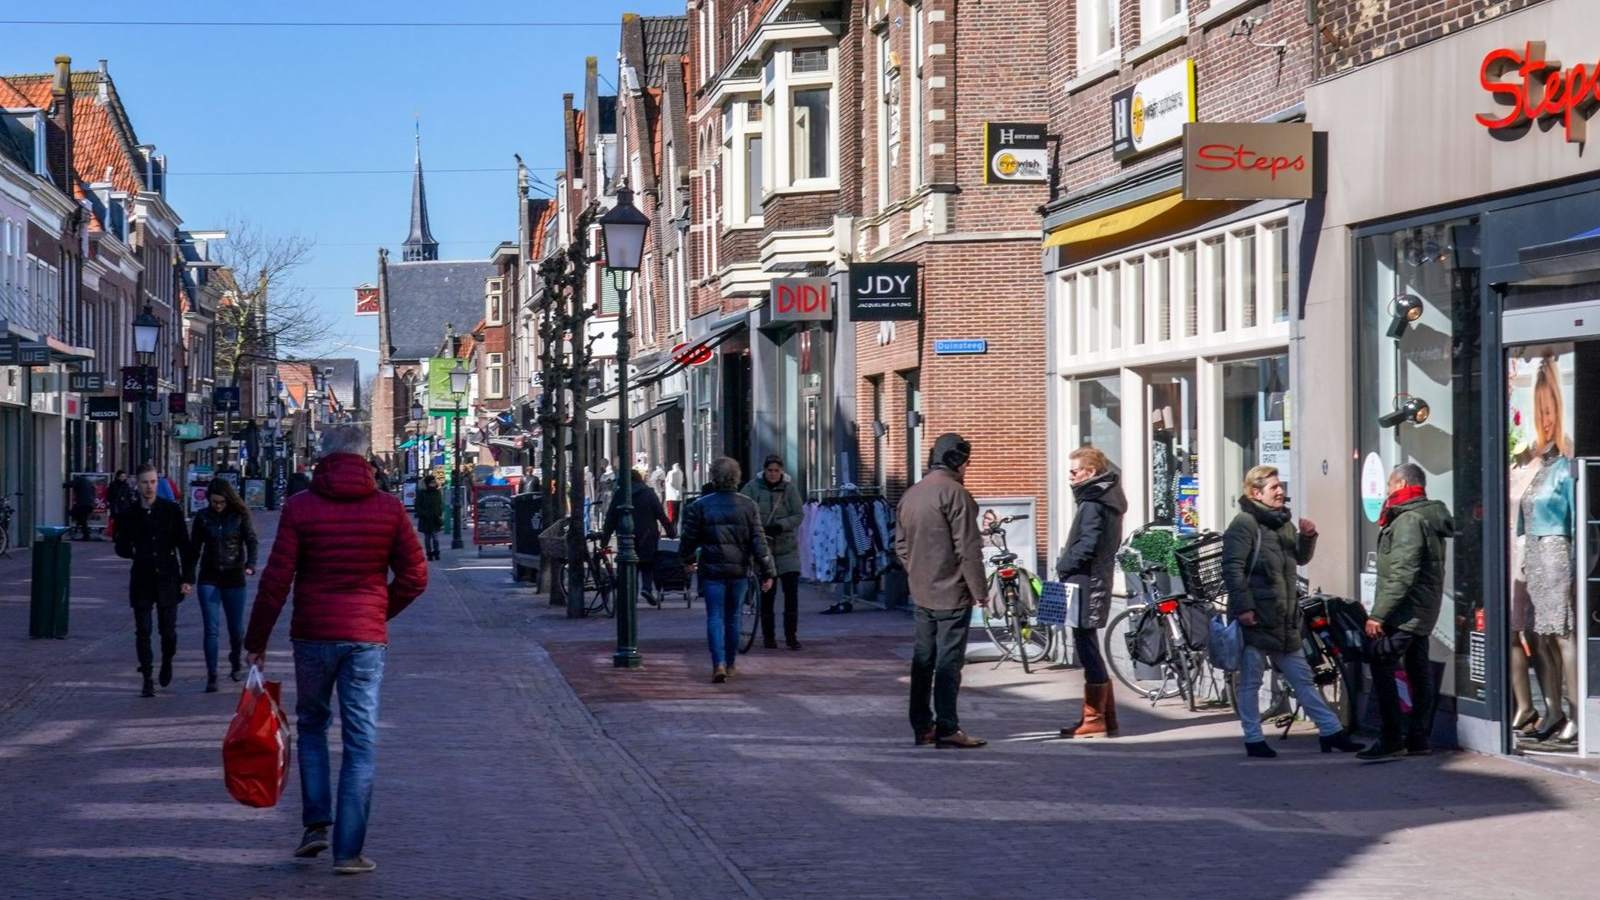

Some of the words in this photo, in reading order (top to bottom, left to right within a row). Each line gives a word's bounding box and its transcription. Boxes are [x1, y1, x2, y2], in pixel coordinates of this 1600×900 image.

[1195, 144, 1305, 181] Steps
[857, 275, 911, 294] JDY
[777, 284, 827, 313] DIDI
[21, 350, 46, 361] WE
[73, 376, 100, 389] WE
